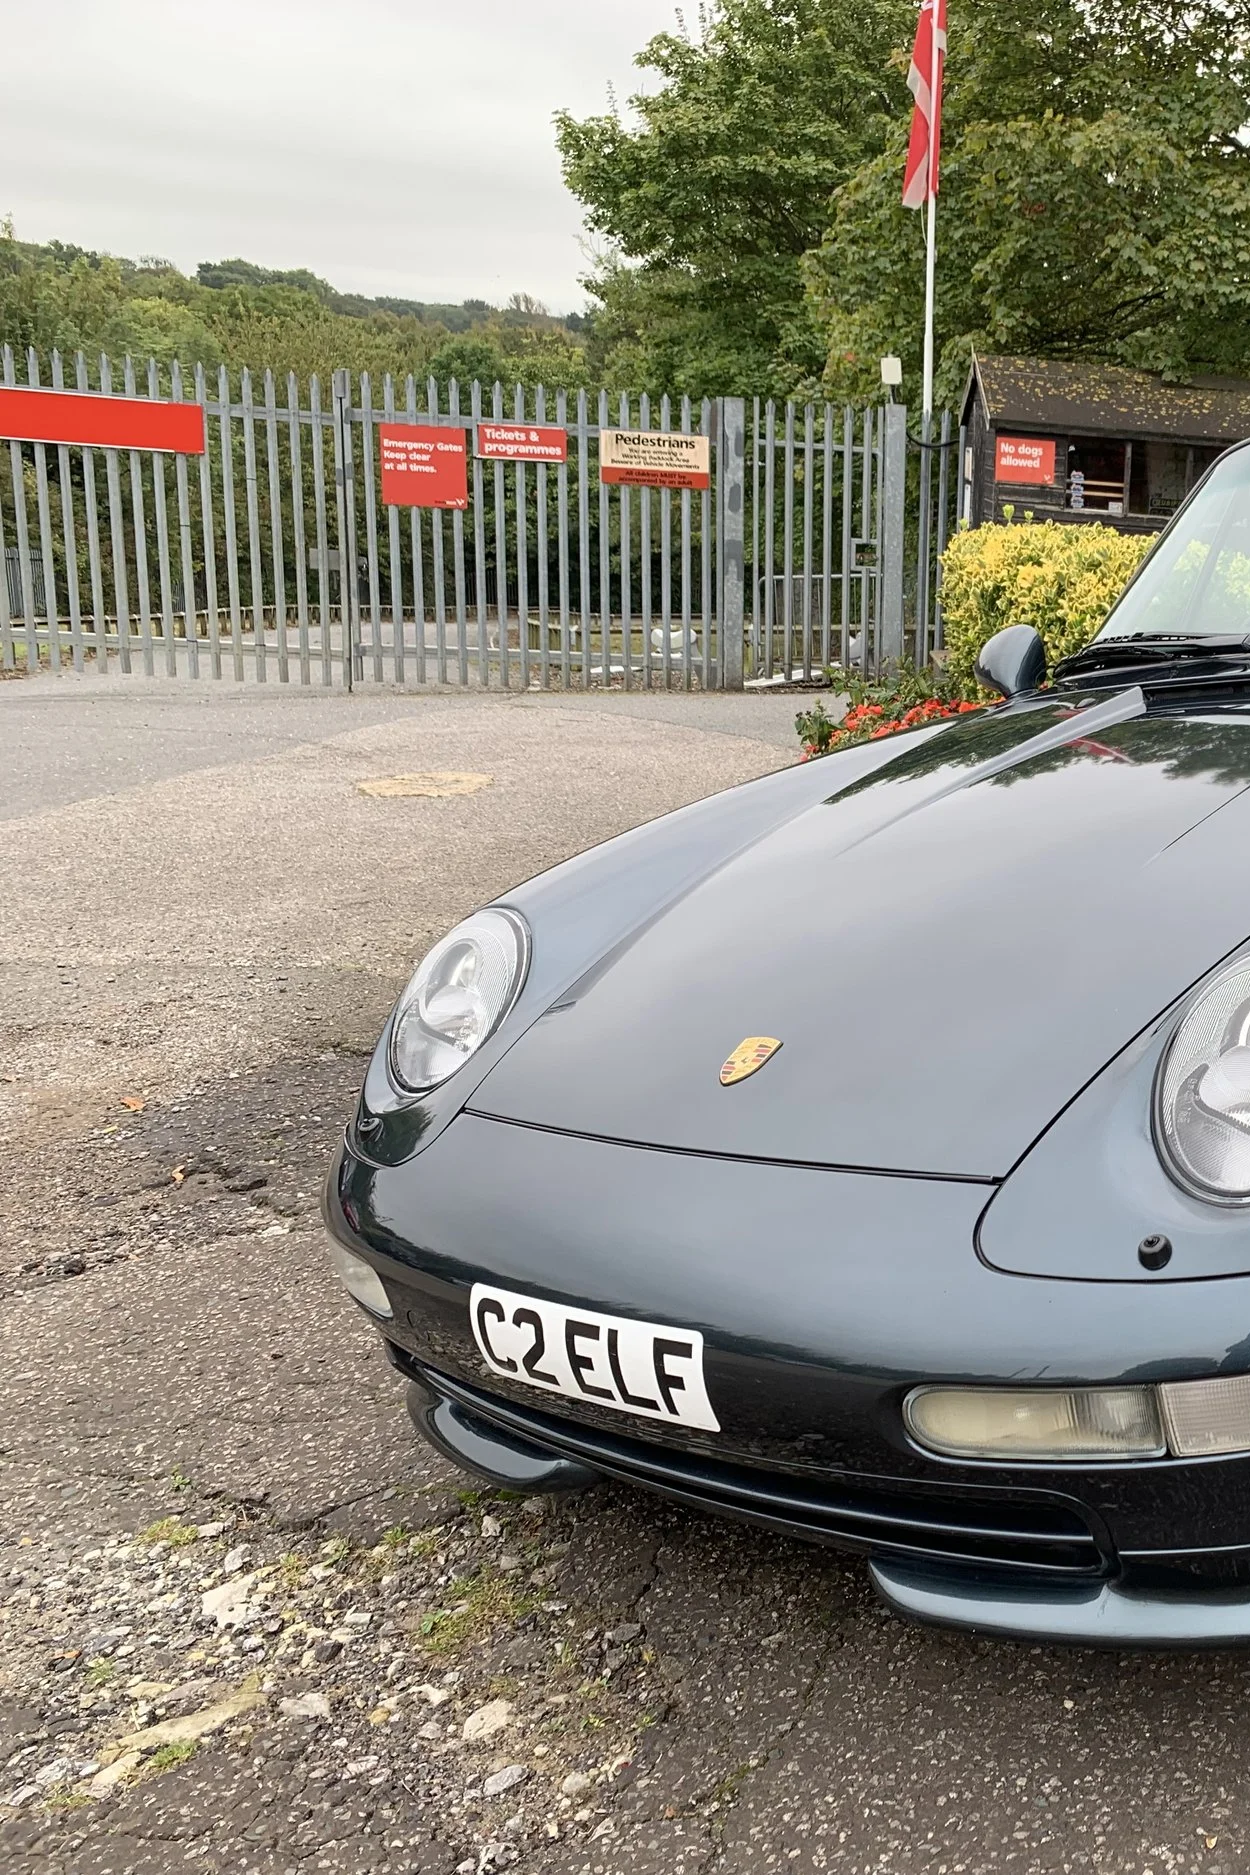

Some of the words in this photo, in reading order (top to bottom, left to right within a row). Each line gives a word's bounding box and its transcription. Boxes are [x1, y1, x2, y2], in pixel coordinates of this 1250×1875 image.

[484, 428, 527, 441] Tickets
[529, 431, 540, 442] &
[615, 433, 696, 449] Pedestrians
[383, 438, 435, 452] Emergency
[437, 442, 463, 452] Gates
[484, 443, 562, 455] programmes
[1000, 442, 1015, 453] No
[1018, 443, 1043, 458] dogs
[383, 450, 407, 461] Keep
[409, 452, 431, 461] clear
[1000, 455, 1041, 468] allowed
[384, 462, 395, 471] at
[396, 462, 407, 471] all
[409, 463, 437, 473] times.
[477, 1297, 561, 1387] C2
[565, 1318, 693, 1417] ELF
